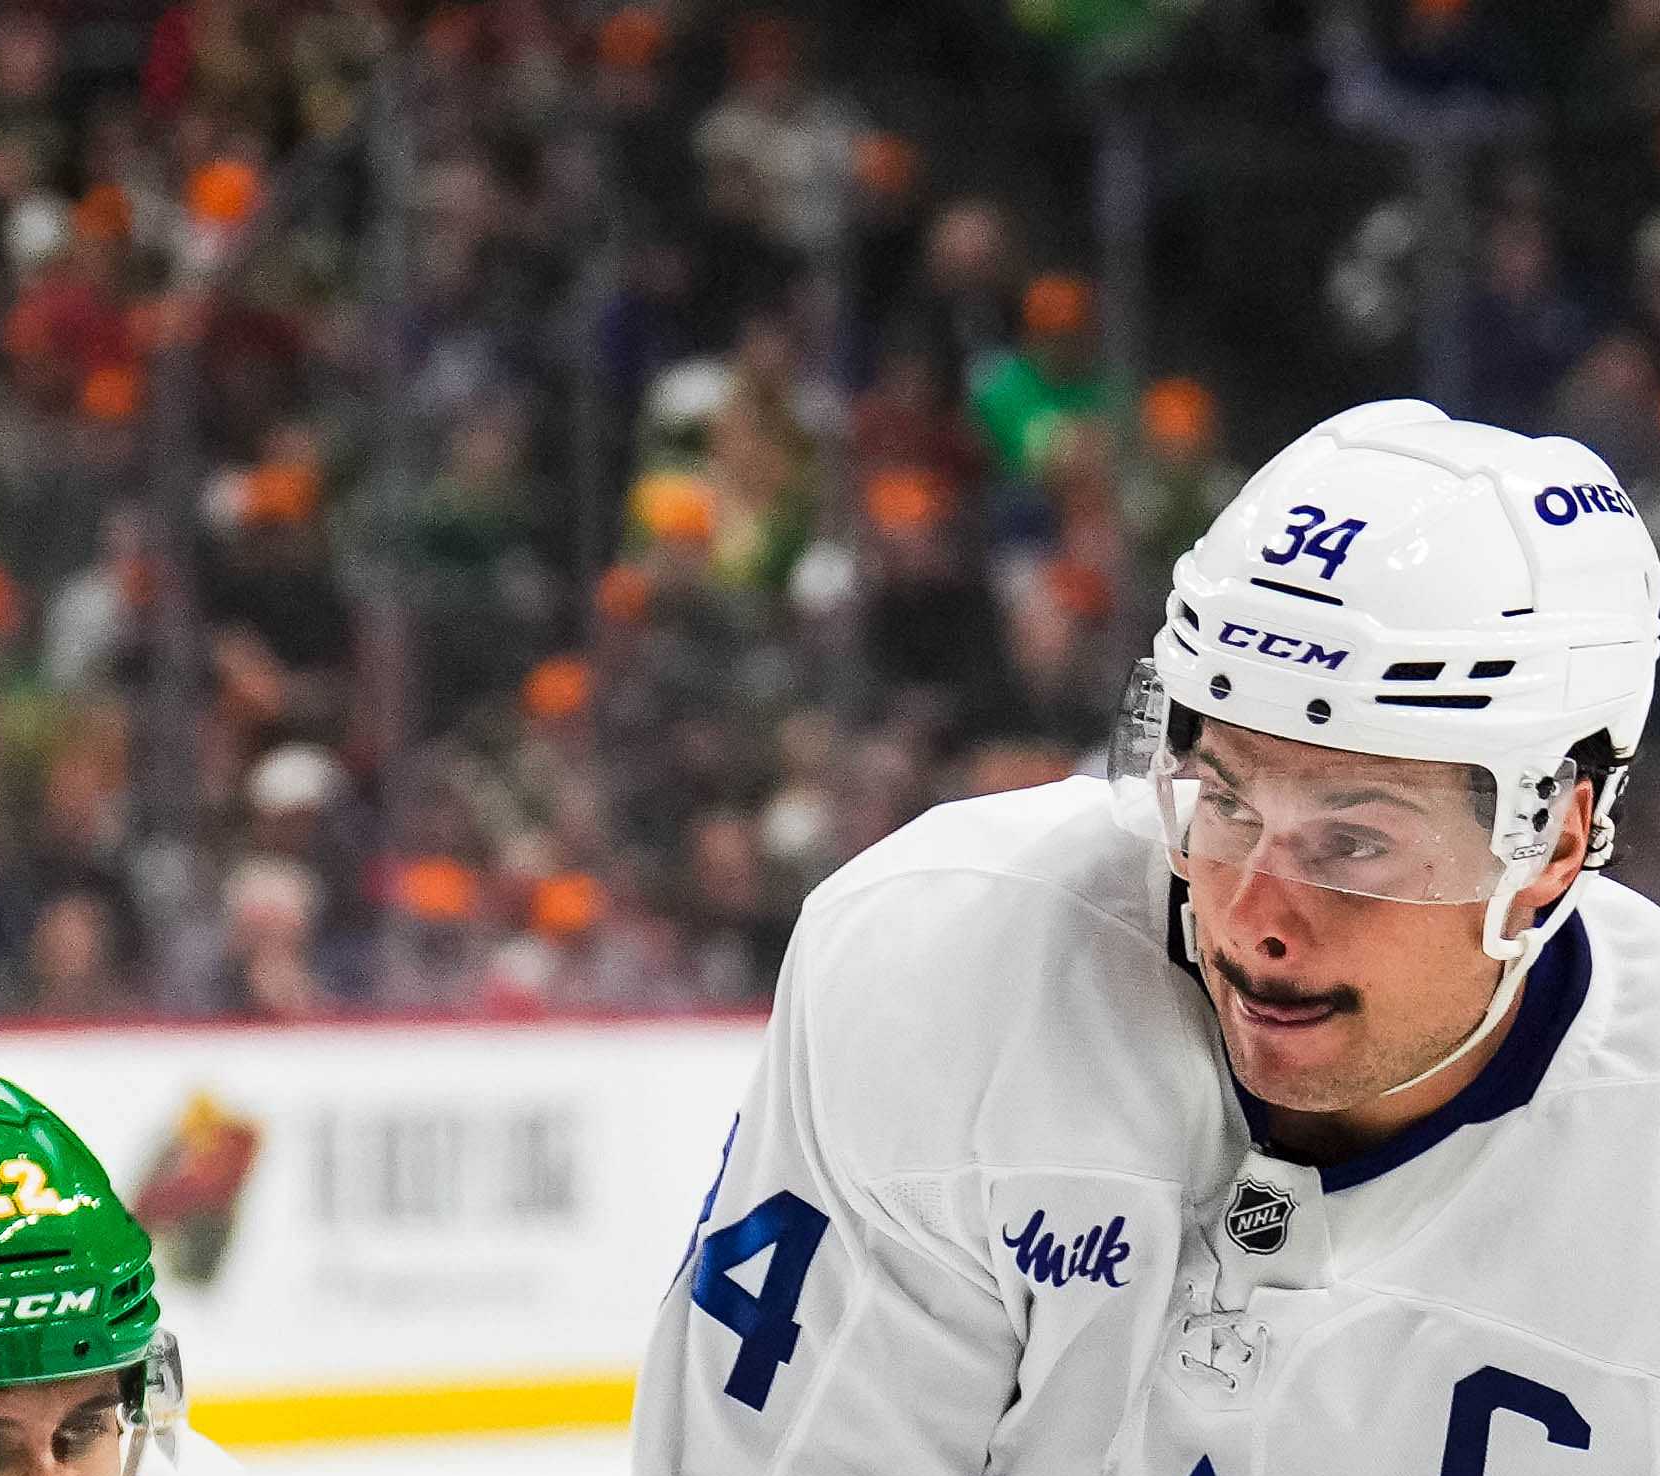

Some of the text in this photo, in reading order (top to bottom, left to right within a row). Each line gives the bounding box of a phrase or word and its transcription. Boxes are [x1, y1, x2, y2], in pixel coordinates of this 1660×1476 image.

[1534, 484, 1634, 526] OREO
[1261, 505, 1367, 580] 34
[1218, 621, 1350, 670] CCM
[1237, 1200, 1283, 1232] NHL
[1002, 1209, 1130, 1288] Milk
